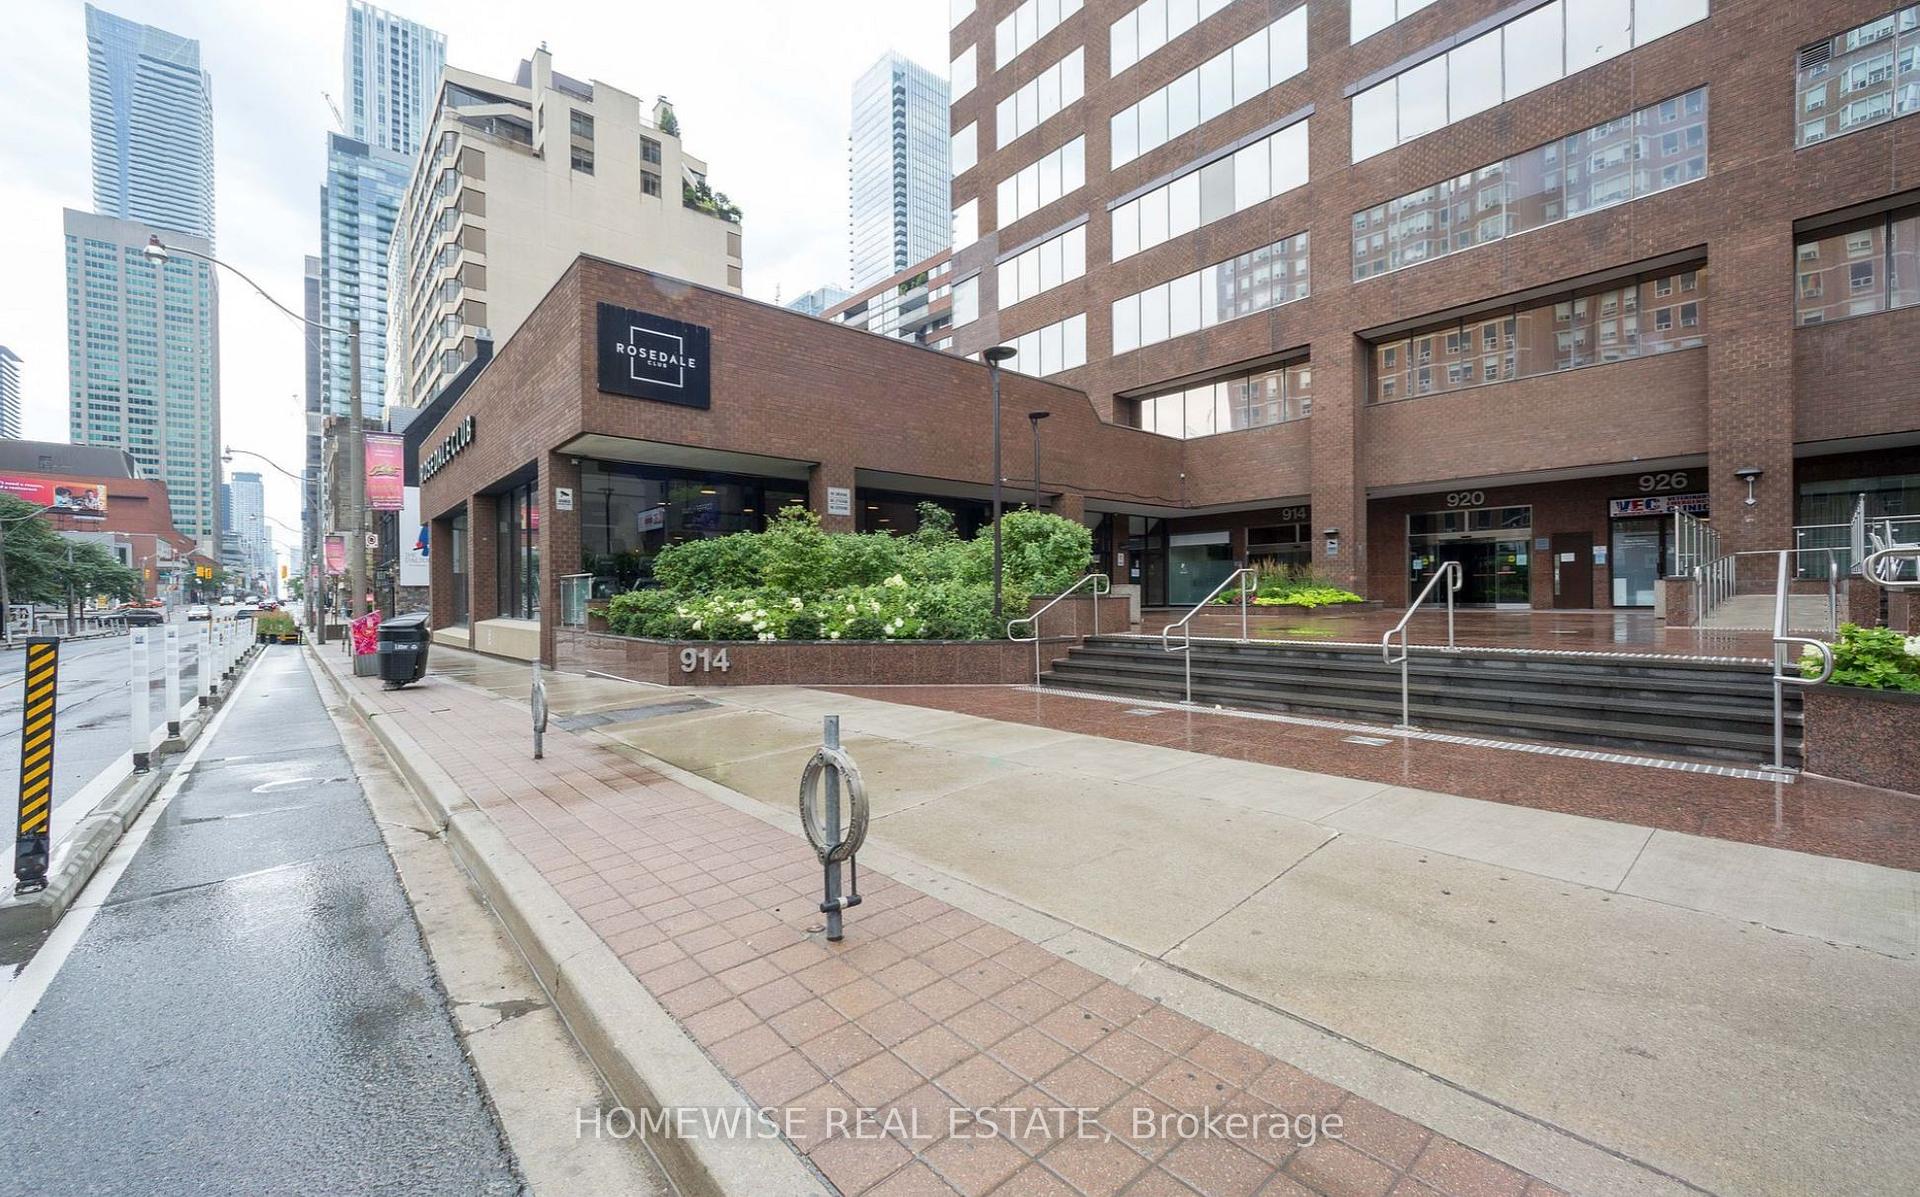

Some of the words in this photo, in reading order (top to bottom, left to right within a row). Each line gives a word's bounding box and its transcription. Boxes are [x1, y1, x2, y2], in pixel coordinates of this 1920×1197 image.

[616, 342, 696, 368] ROSEDALE
[647, 360, 668, 368] CLUB
[1639, 472, 1688, 491] 926
[1447, 491, 1484, 506] 920
[1616, 498, 1660, 512] VEC
[1282, 507, 1306, 520] 914
[680, 648, 730, 672] 914
